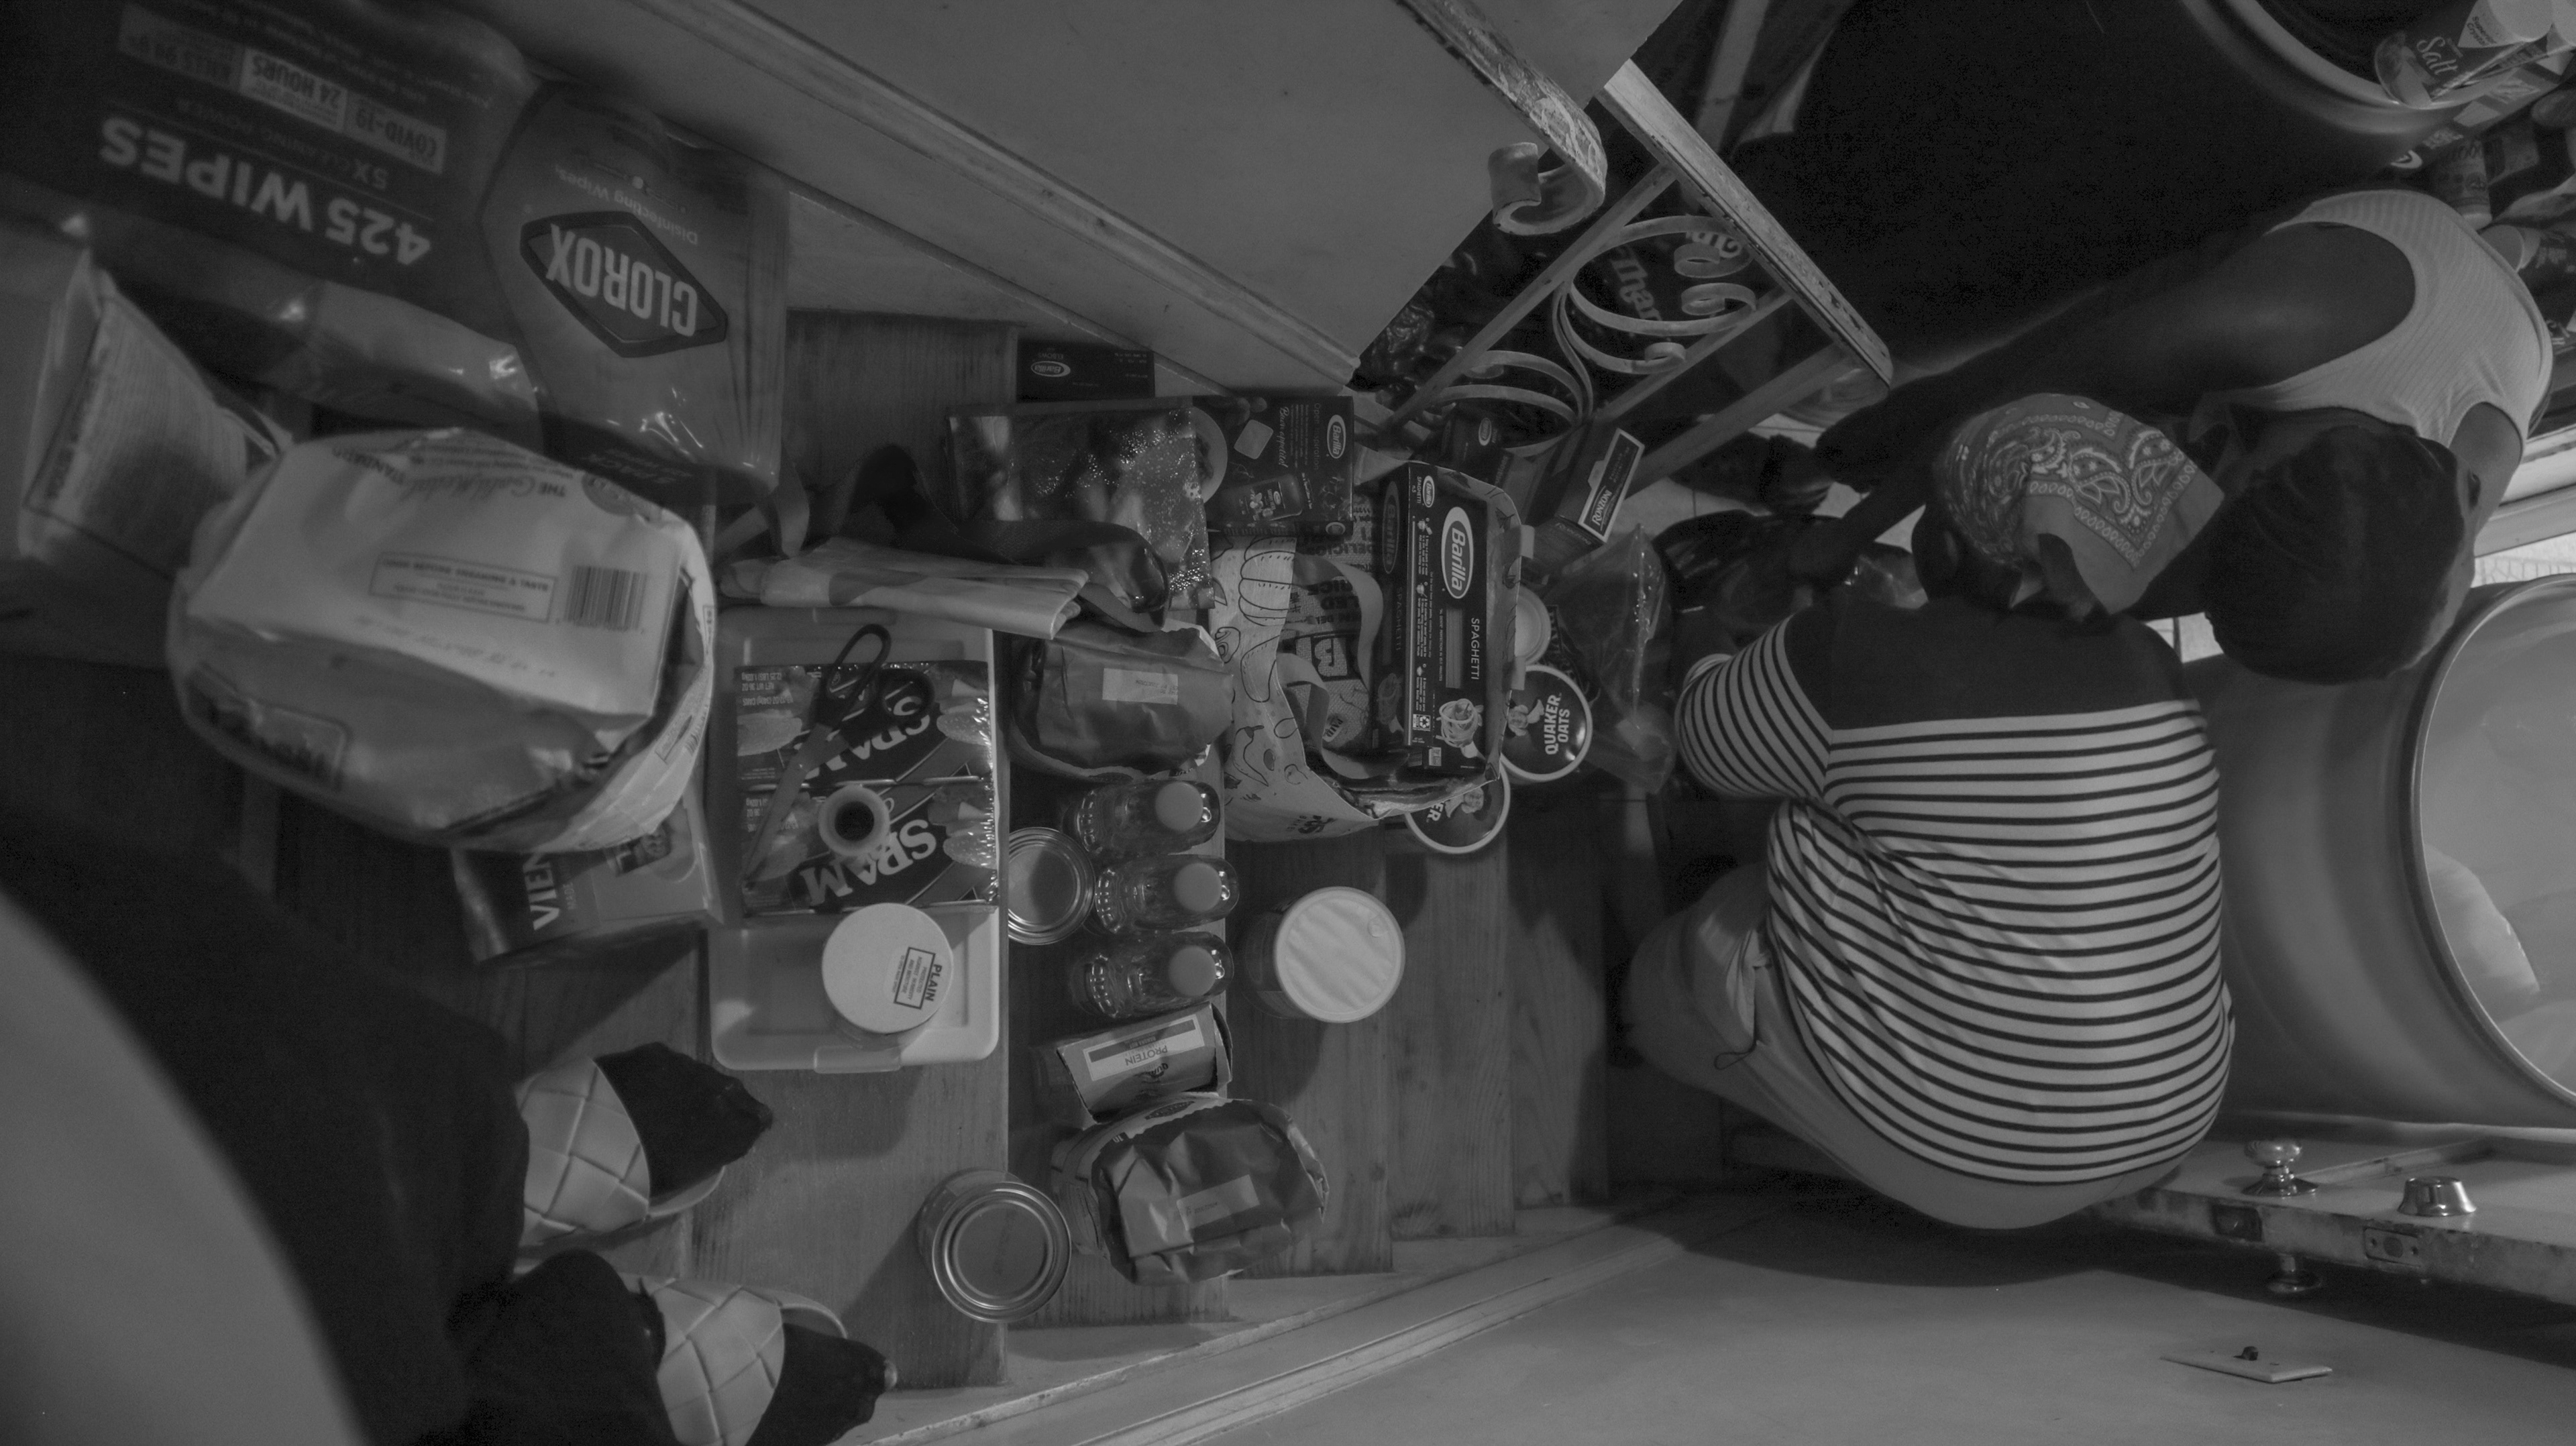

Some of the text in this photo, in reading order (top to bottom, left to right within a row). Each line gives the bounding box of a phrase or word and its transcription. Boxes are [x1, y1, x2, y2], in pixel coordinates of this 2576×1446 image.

[2416, 36, 2459, 76] Salt
[250, 54, 316, 104] HOURS
[317, 83, 341, 111] 24
[354, 105, 438, 158] COVID-19
[98, 116, 431, 266] 425 WIPES
[351, 158, 390, 190] 5X
[614, 190, 698, 245] Disinfecting
[545, 223, 698, 337] CLOROX
[1313, 402, 1322, 425] Open
[1332, 424, 1341, 455] Barilla
[539, 480, 566, 498] THE
[1425, 482, 1433, 504] Barilla
[1451, 527, 1466, 592] Barilla
[1470, 618, 1481, 680] SPAGHETTI
[1544, 691, 1562, 756] QUAKER
[1557, 707, 1571, 744] OATS
[799, 818, 937, 906] SPAM
[522, 851, 561, 932] VIEN
[925, 964, 943, 1001] PLAIN
[1124, 1045, 1169, 1066] PROTEIN
